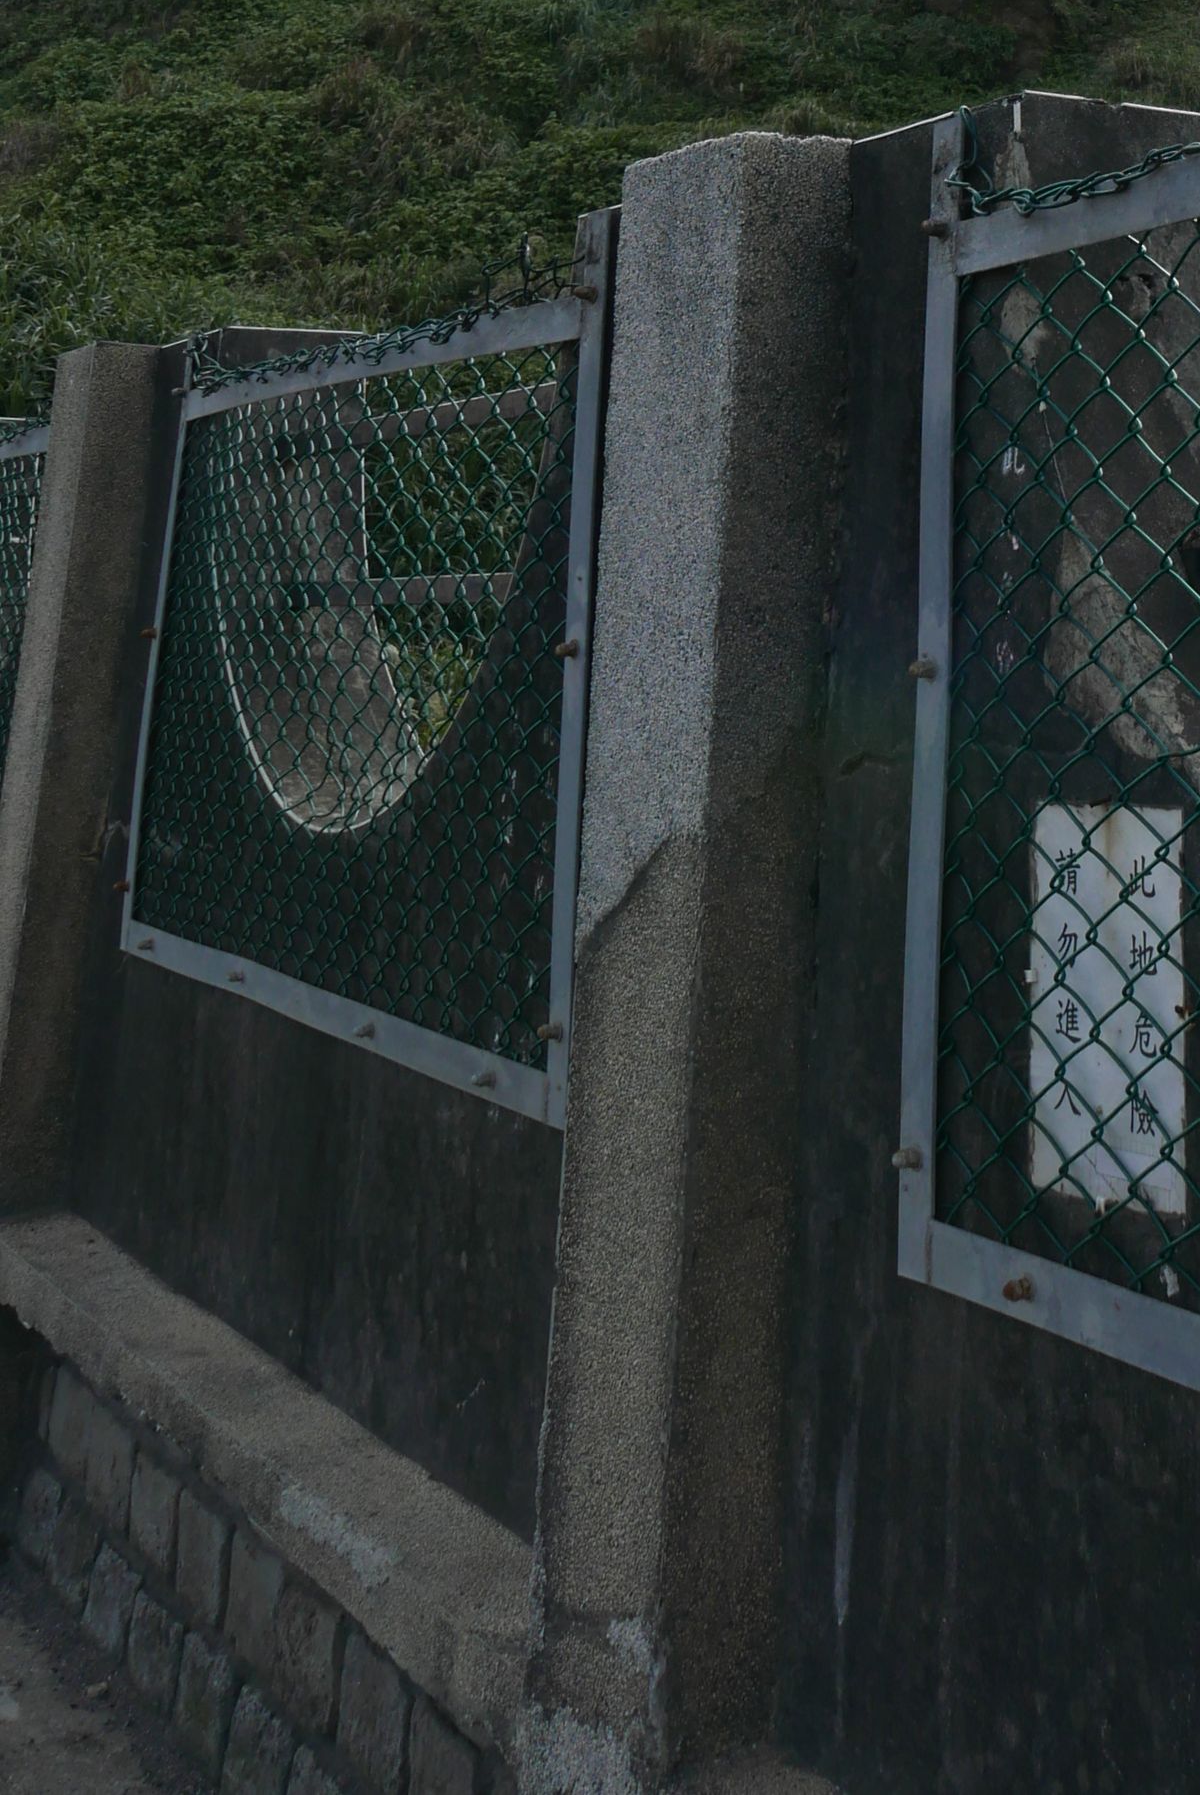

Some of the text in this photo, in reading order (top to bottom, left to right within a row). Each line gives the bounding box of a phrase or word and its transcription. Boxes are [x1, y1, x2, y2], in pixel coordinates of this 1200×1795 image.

[1054, 848, 1083, 1116] 請勿進入
[1128, 855, 1158, 1137] 此地危險
